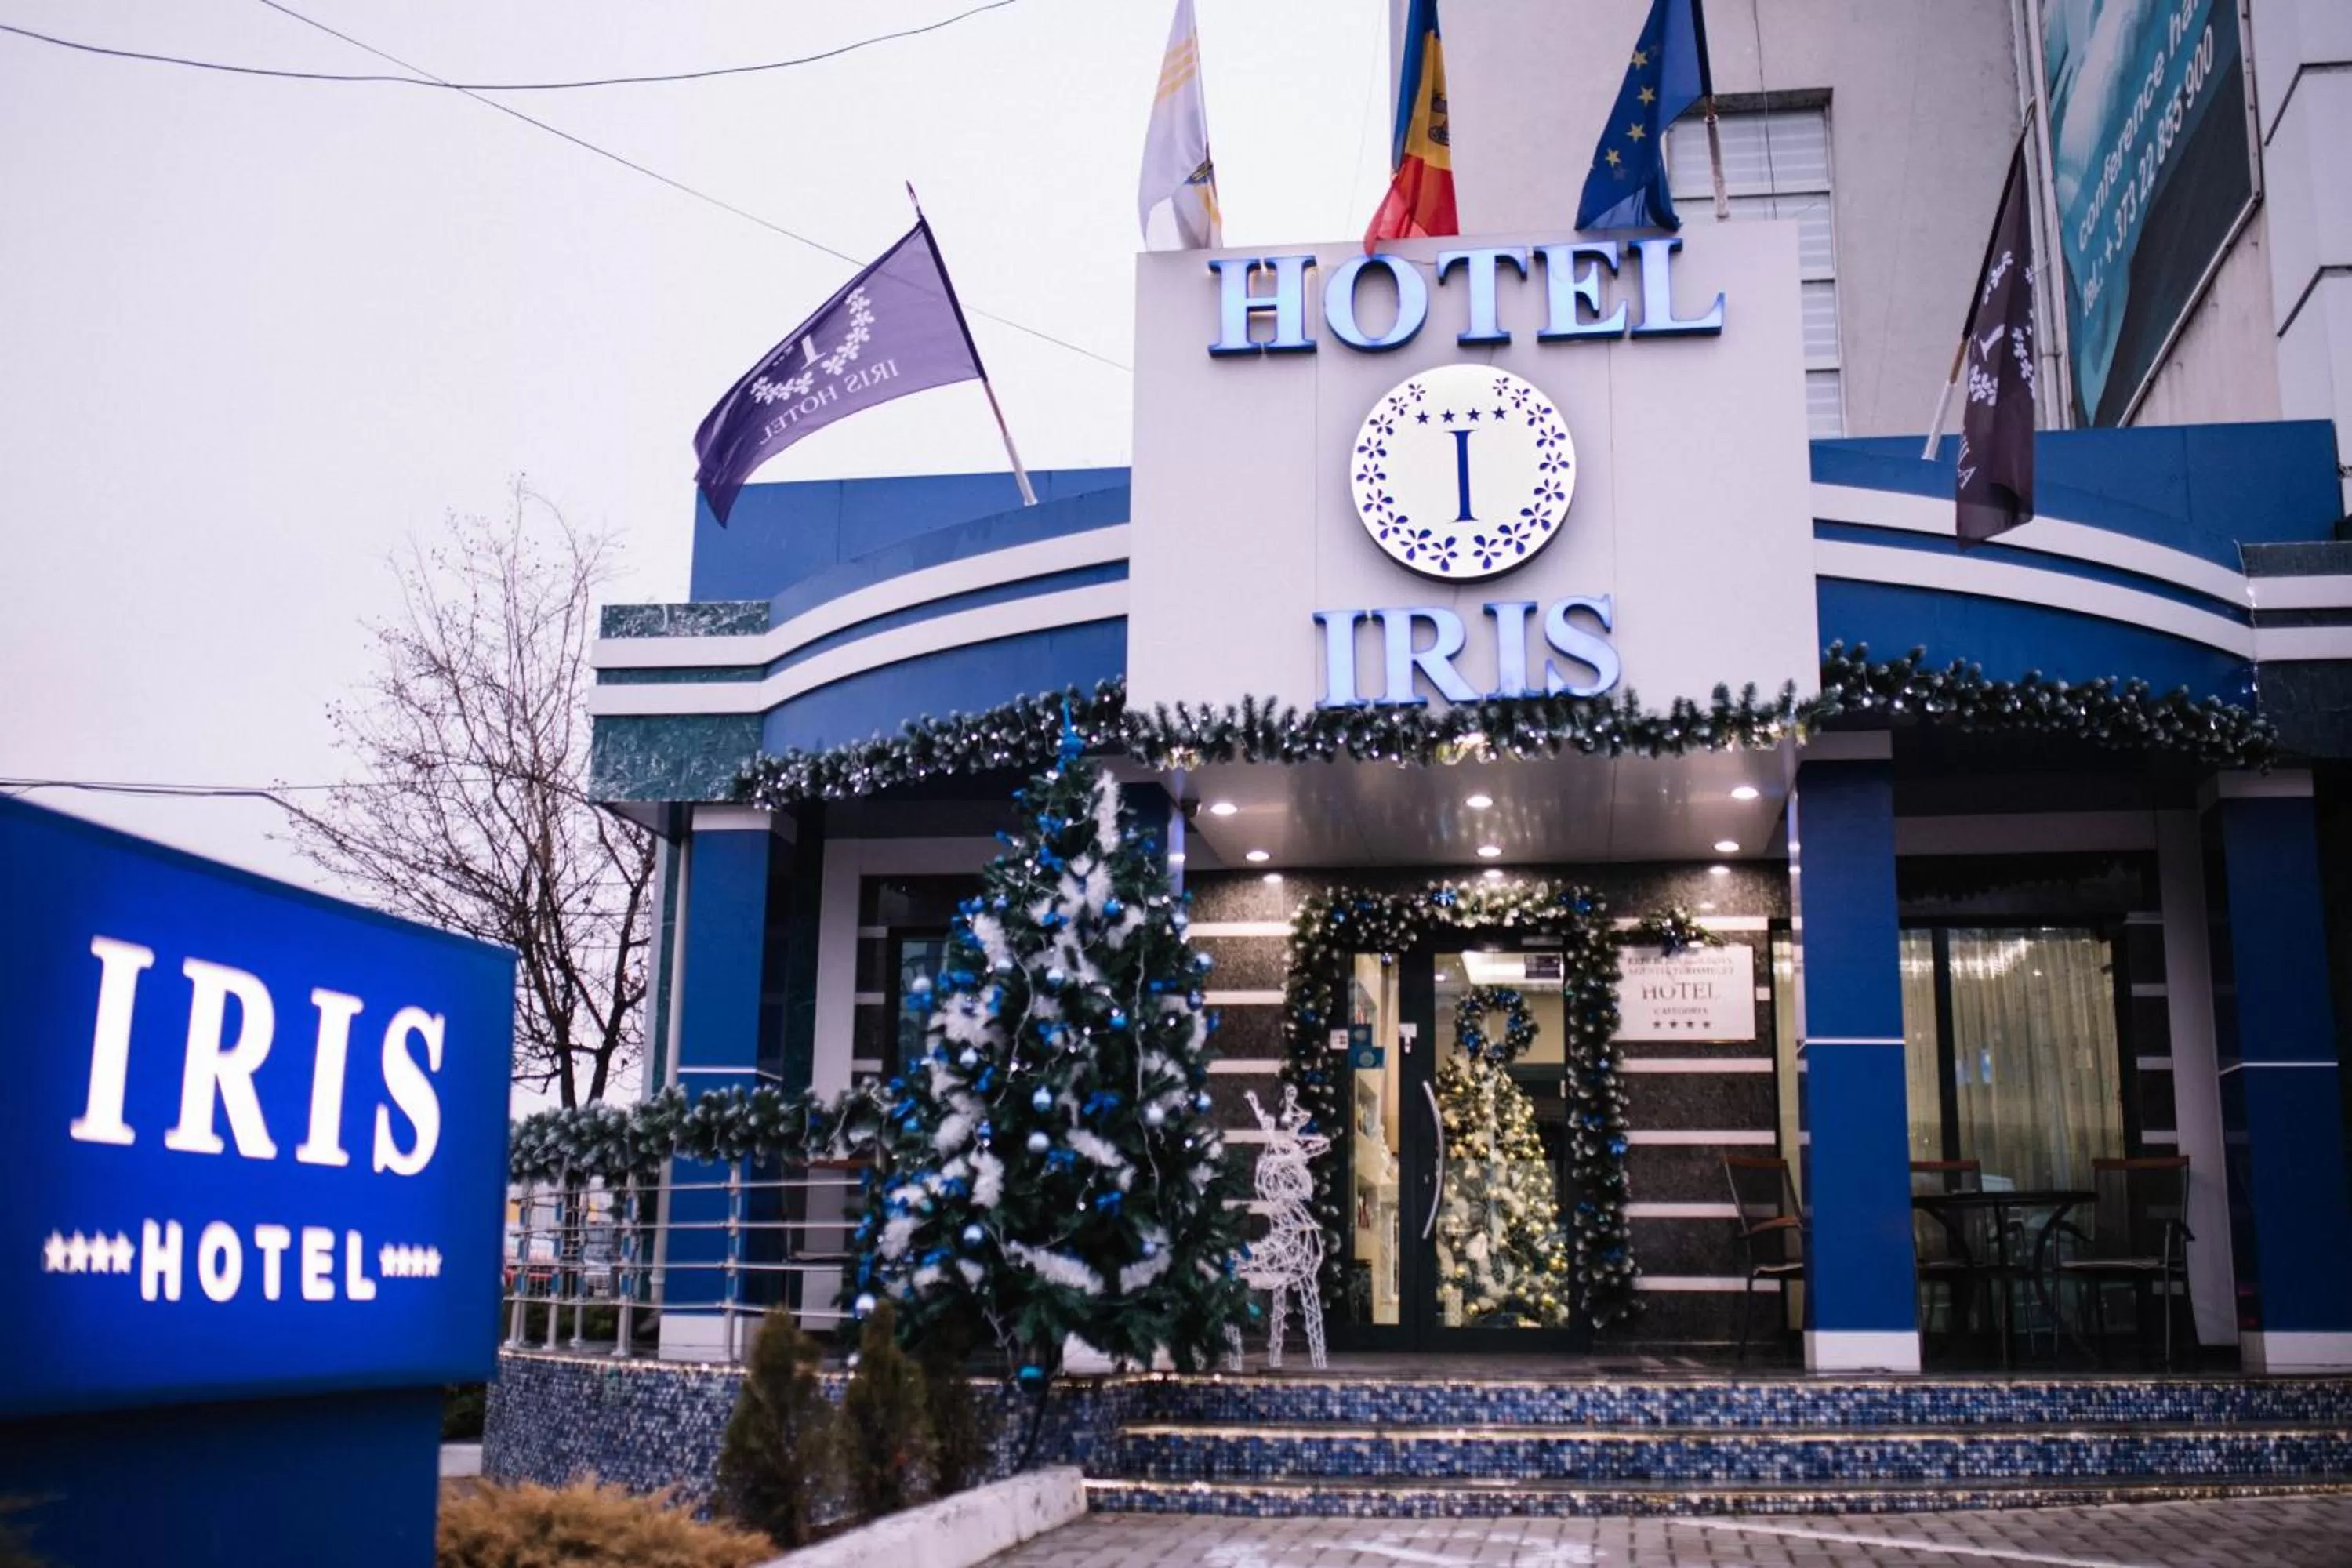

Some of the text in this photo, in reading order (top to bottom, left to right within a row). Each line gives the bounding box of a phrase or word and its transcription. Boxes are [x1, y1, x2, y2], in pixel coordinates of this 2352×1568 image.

[2079, 50, 2165, 252] conference
[2139, 142, 2155, 204] 22
[2157, 84, 2182, 165] 855
[2185, 24, 2213, 110] 900
[1208, 238, 1725, 358] HOTEL
[1312, 594, 1621, 710] IRIS
[1642, 982, 1720, 1000] HOTEL
[70, 934, 445, 1176] IRIS
[140, 1217, 376, 1302] HOTEL
